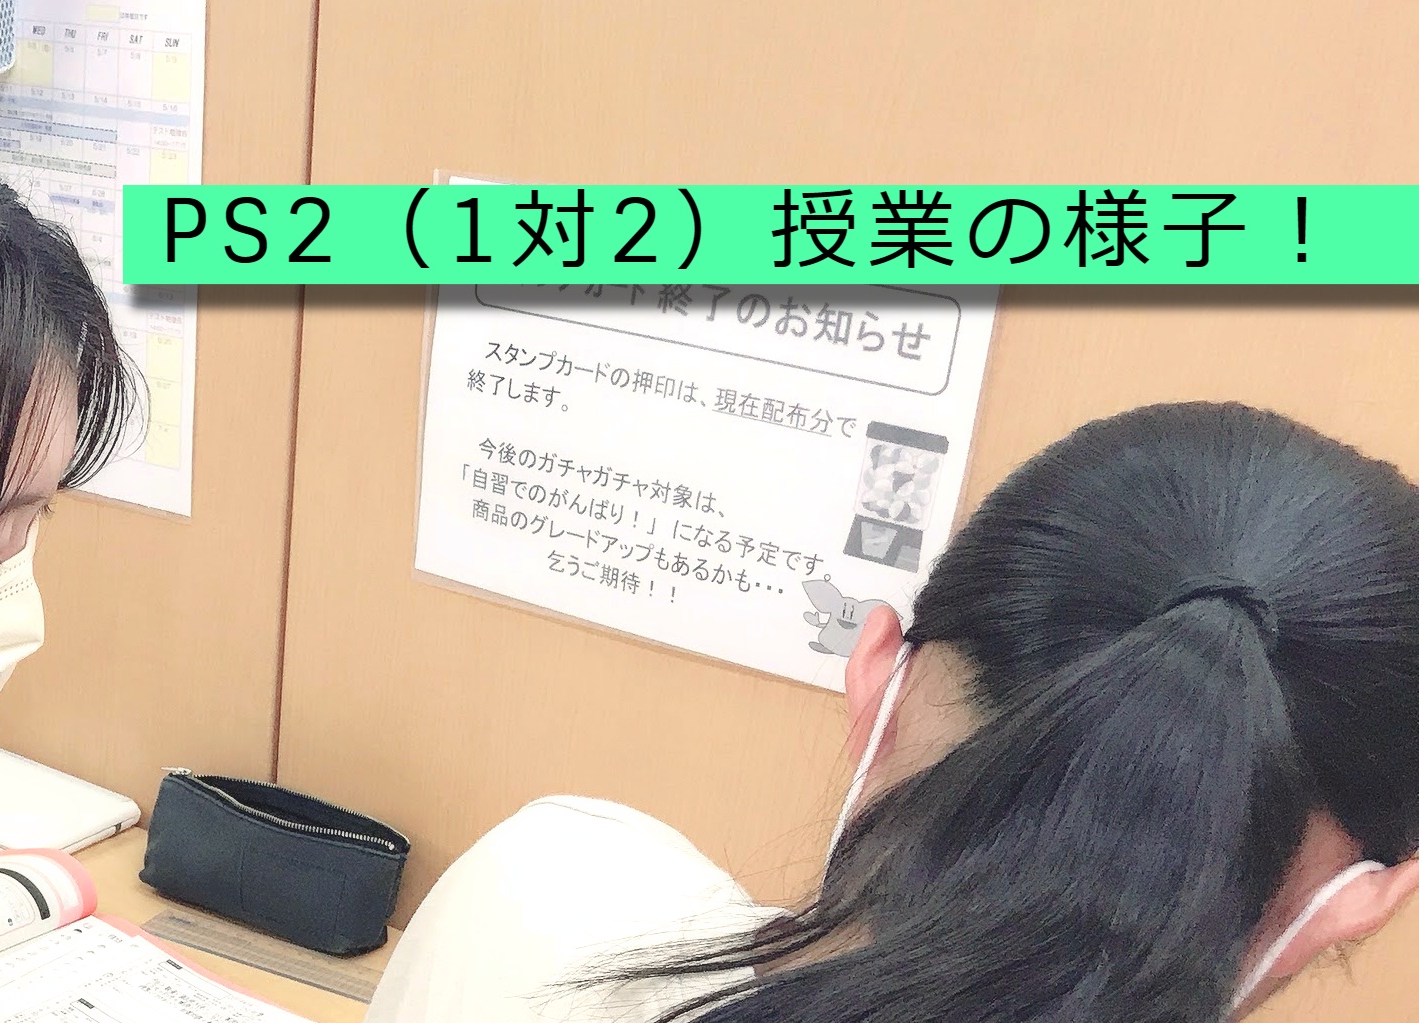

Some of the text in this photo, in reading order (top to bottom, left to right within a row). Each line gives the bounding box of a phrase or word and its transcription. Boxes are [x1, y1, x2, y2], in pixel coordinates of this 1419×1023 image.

[32, 25, 180, 48] WED THU FRI SAT SUN
[467, 369, 568, 412] 終了します。
[485, 342, 857, 437] スタンプカードの押印は、現在配布分で
[479, 437, 726, 518] 今後のガチャガチャ対象は、
[547, 550, 677, 603] 乞うご期待！！
